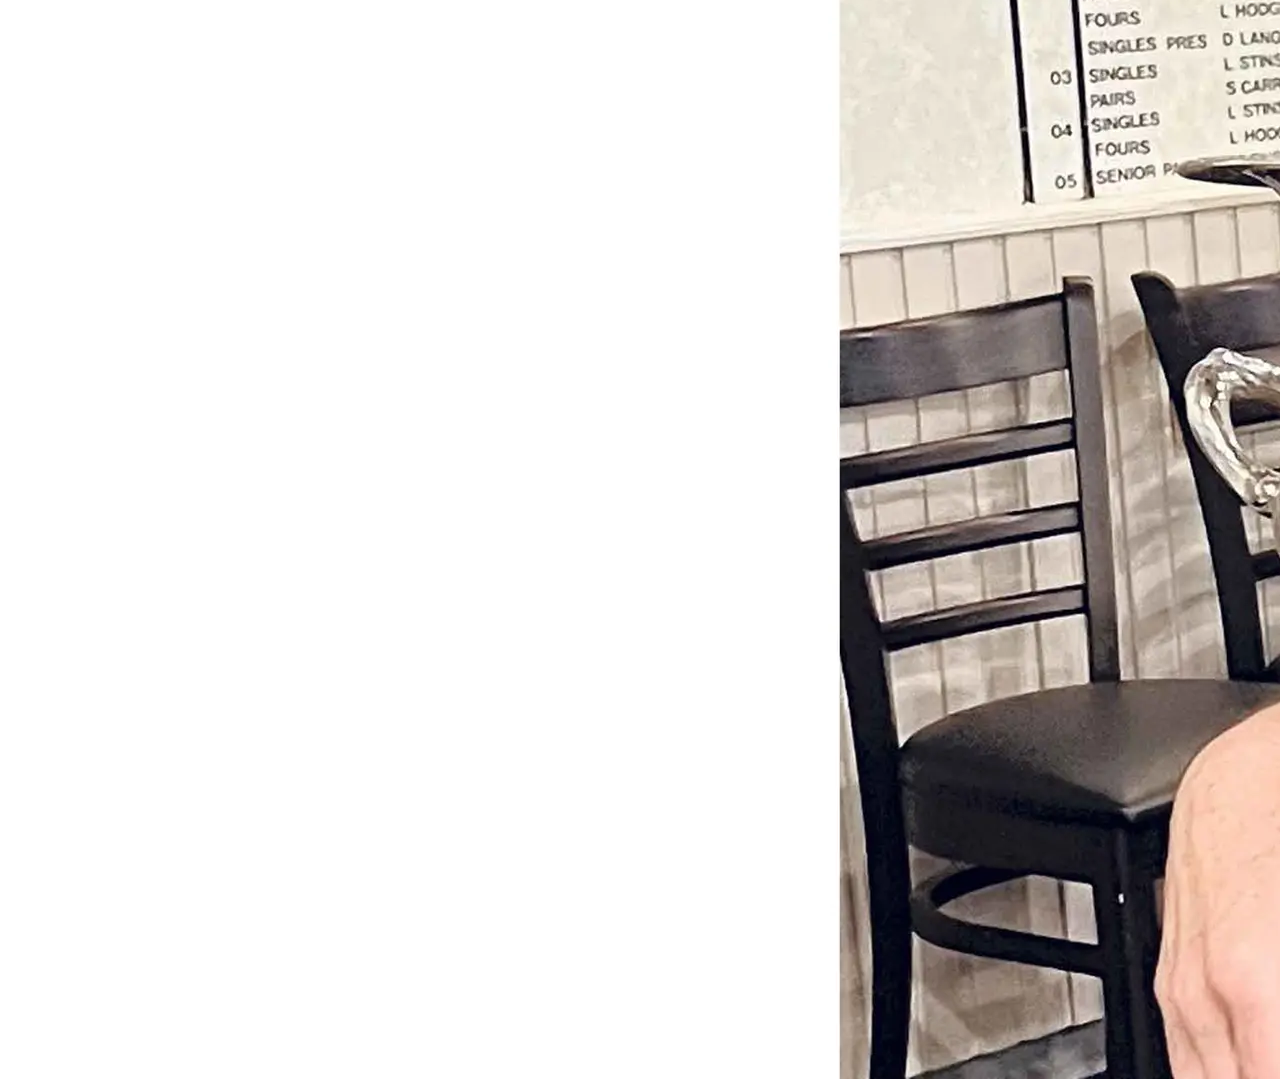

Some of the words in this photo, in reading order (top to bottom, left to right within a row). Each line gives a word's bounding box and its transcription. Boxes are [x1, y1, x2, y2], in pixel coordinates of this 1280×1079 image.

[1085, 11, 1141, 27] FOURS
[1088, 37, 1157, 55] SINGLES
[1167, 34, 1207, 50] PRES
[1050, 71, 1071, 85] 03
[1089, 64, 1157, 83] SINGLES
[1051, 124, 1072, 139] 04
[1091, 112, 1160, 132] SINGLES
[1055, 175, 1076, 189] 05
[1097, 164, 1156, 184] SENIOR
